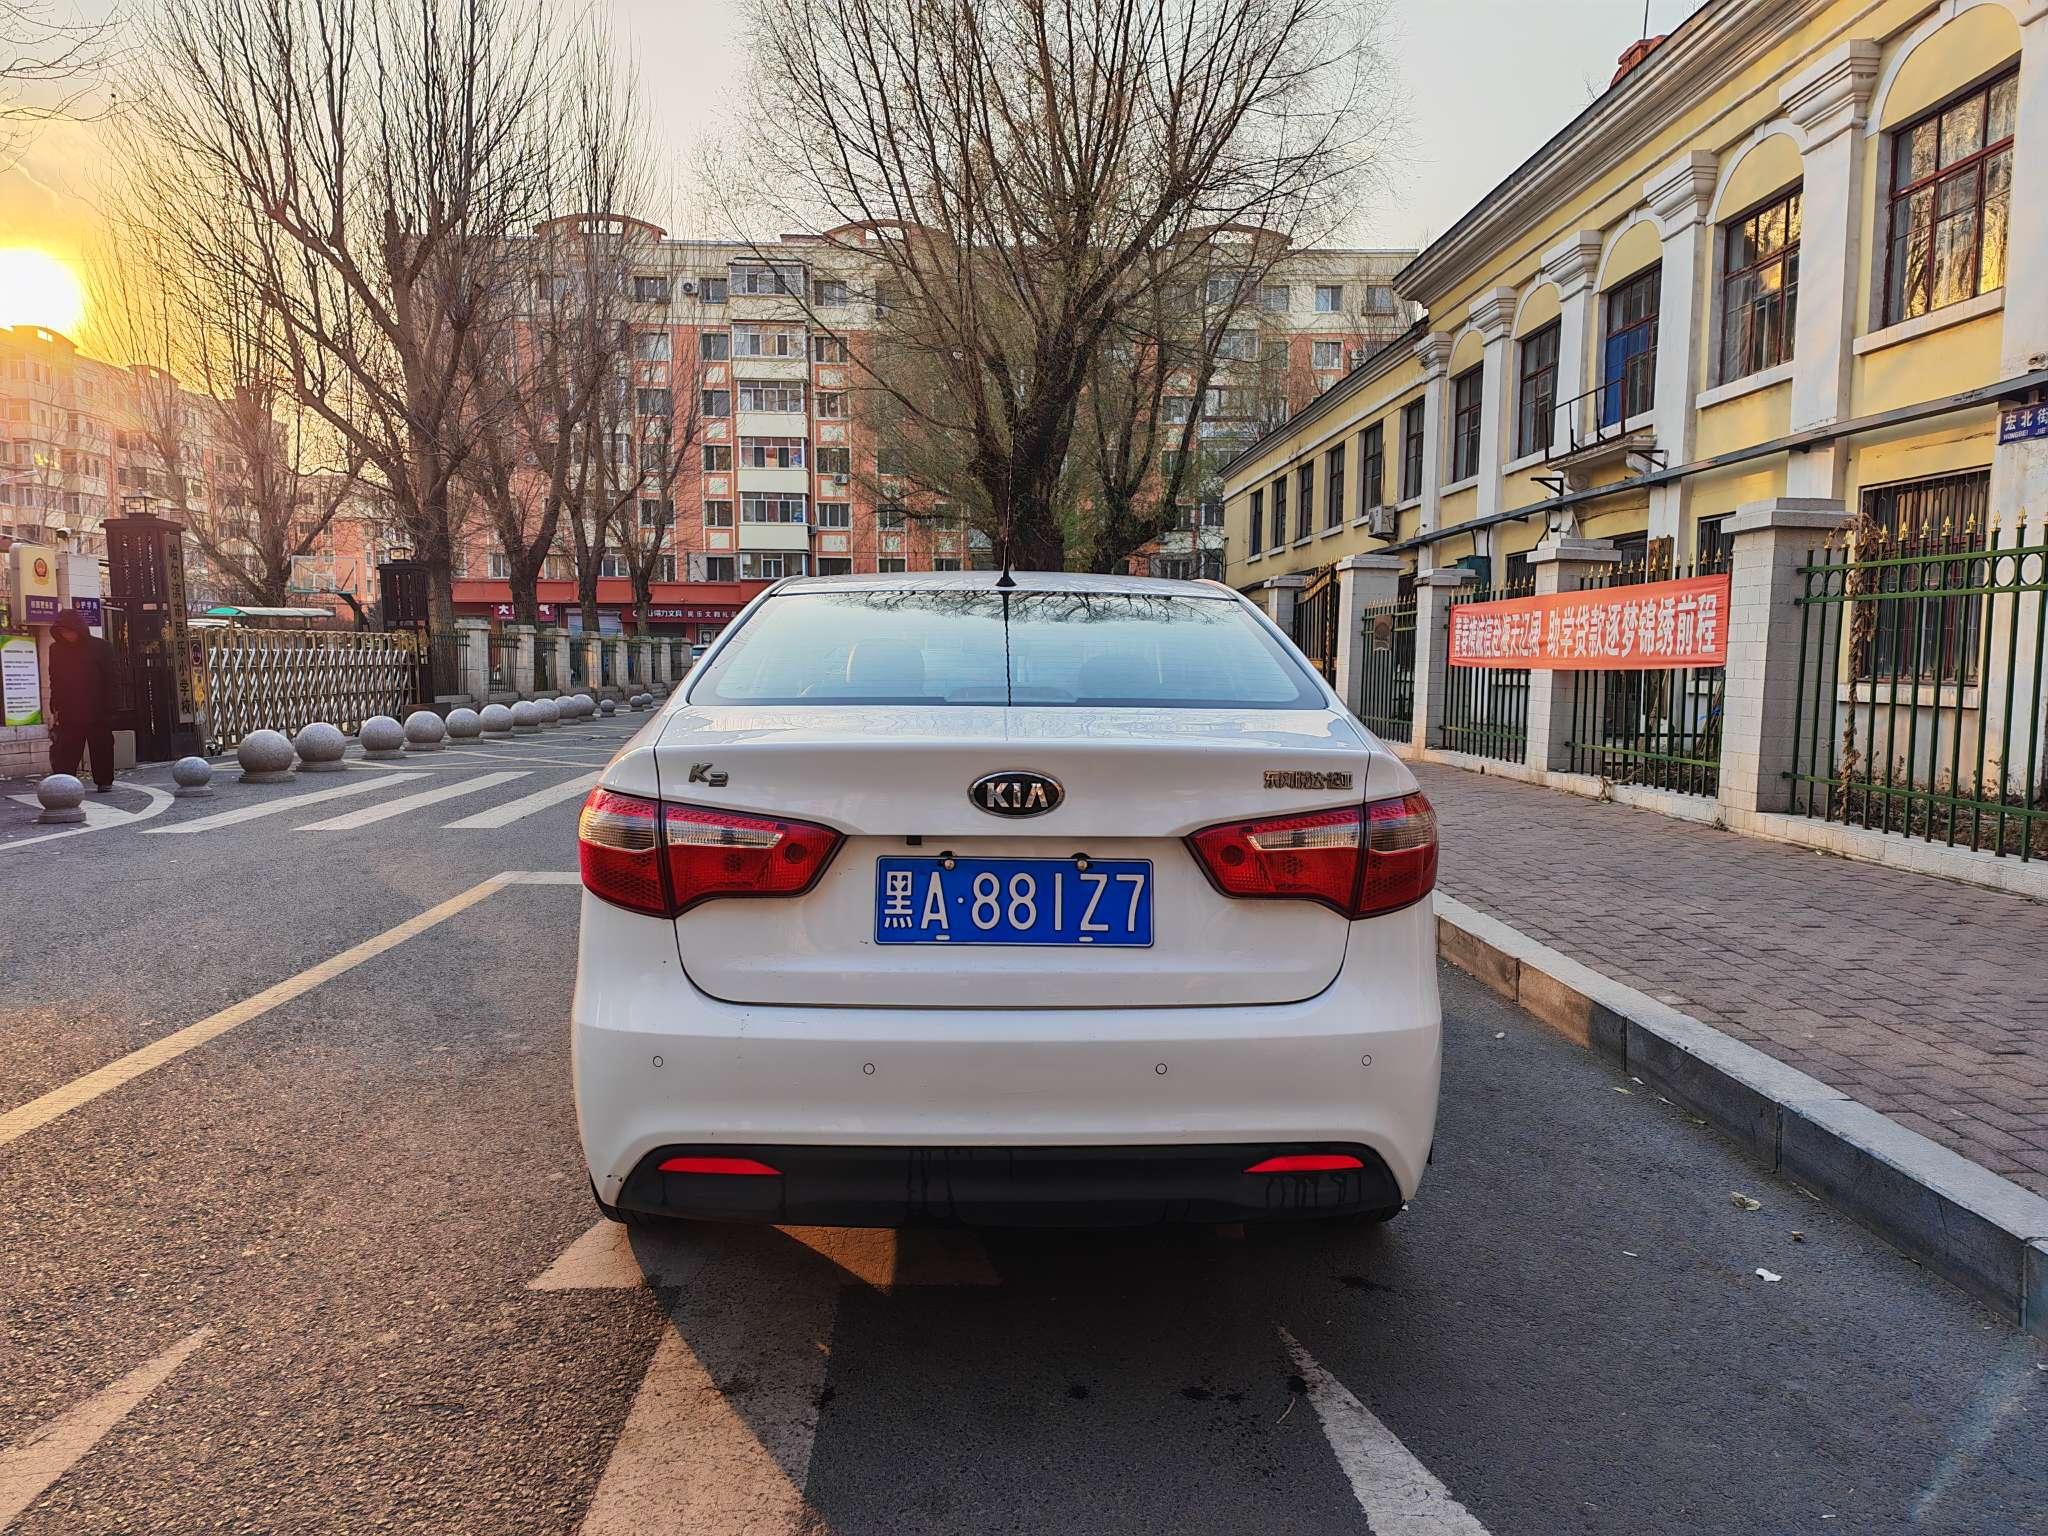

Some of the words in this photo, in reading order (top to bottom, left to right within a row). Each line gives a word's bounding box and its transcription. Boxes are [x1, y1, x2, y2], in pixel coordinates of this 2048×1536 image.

[2004, 407, 2048, 431] 宏北街
[1547, 593, 1717, 659] 助学贷款逐梦锦绣前程
[688, 762, 729, 788] K2
[986, 782, 1049, 808] KIA
